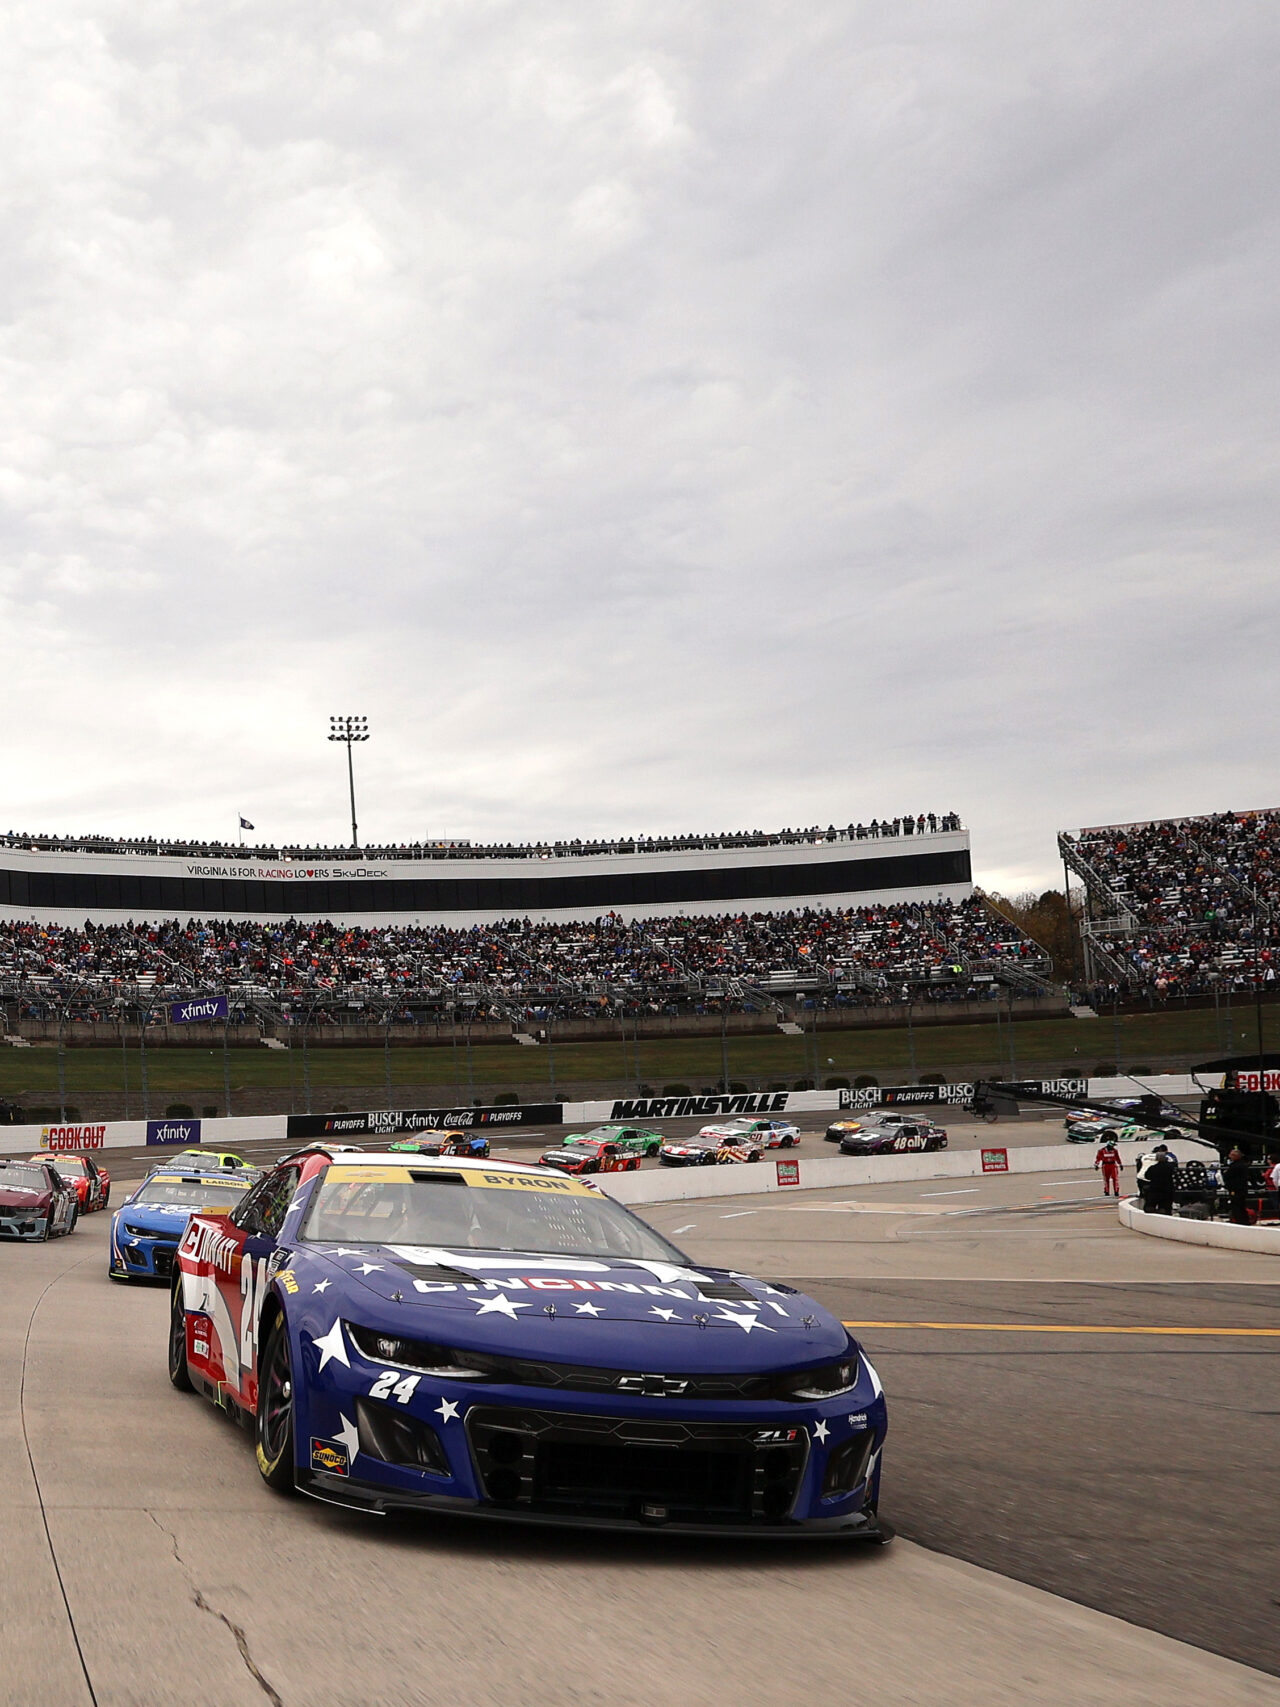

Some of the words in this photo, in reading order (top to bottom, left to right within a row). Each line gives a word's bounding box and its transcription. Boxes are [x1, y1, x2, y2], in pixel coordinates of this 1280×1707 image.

[187, 866, 228, 876] VIRGINIA
[230, 867, 237, 876] IS
[239, 867, 256, 877] FOR
[258, 869, 294, 878] RACING
[181, 1001, 218, 1019] xfinity
[938, 1085, 974, 1099] BUSC
[1042, 1080, 1086, 1093] BUSCH
[841, 1088, 882, 1103] BUSCH
[897, 1092, 934, 1102] PLAYOFFS
[610, 1093, 789, 1119] MARTINSVILLE
[367, 1112, 403, 1128] BUSCH
[405, 1114, 440, 1129] xfinity
[490, 1112, 522, 1122] PLAYOFFS
[333, 1120, 365, 1130] PLAYOFFS
[375, 1126, 395, 1134] LIGHT
[49, 1127, 82, 1150] COOK
[83, 1126, 106, 1149] OUT
[156, 1126, 191, 1141] xfinity
[894, 1137, 906, 1149] 48
[907, 1136, 927, 1149] ally
[484, 1175, 570, 1190] BYRON
[129, 1238, 141, 1246] 5
[369, 1371, 421, 1404] 24
[313, 1449, 347, 1465] SUNOCO
